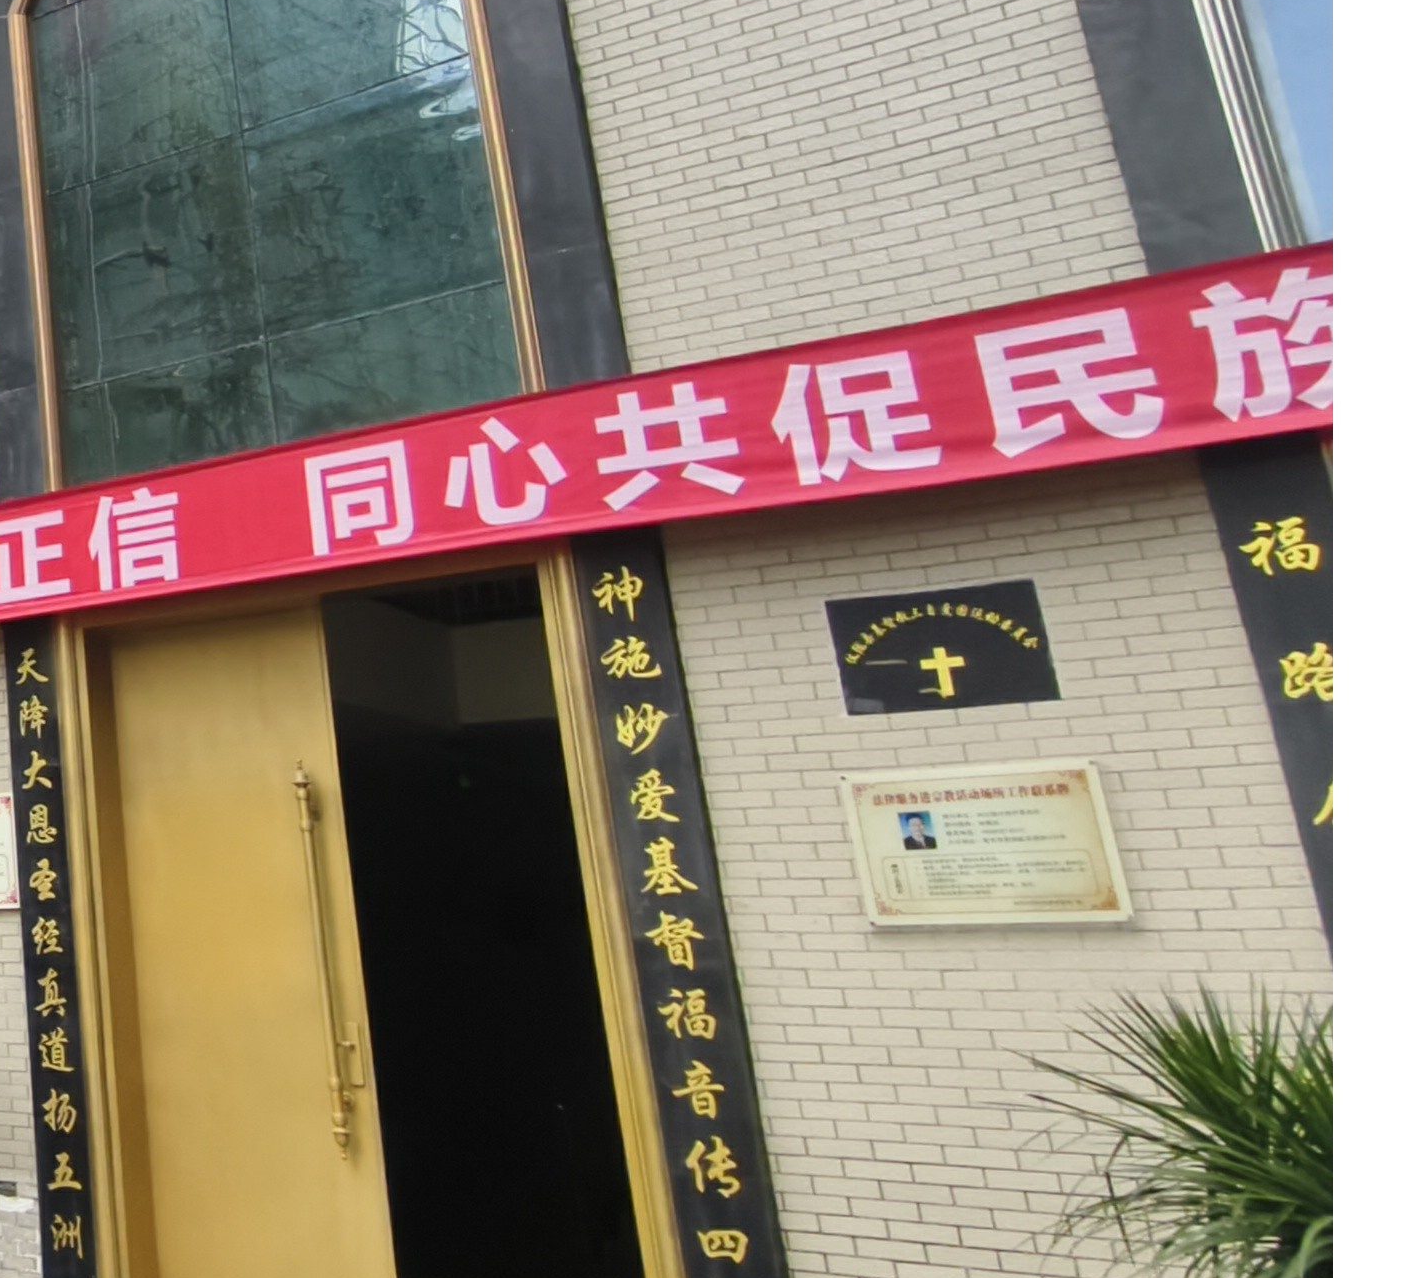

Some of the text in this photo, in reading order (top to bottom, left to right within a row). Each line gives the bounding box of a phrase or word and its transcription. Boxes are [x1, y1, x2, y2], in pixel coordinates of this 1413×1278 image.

[304, 267, 1333, 557] 同心共促民族
[1239, 517, 1333, 825] 福路
[16, 647, 84, 1260] 天降大恩圣经真道扬五洲
